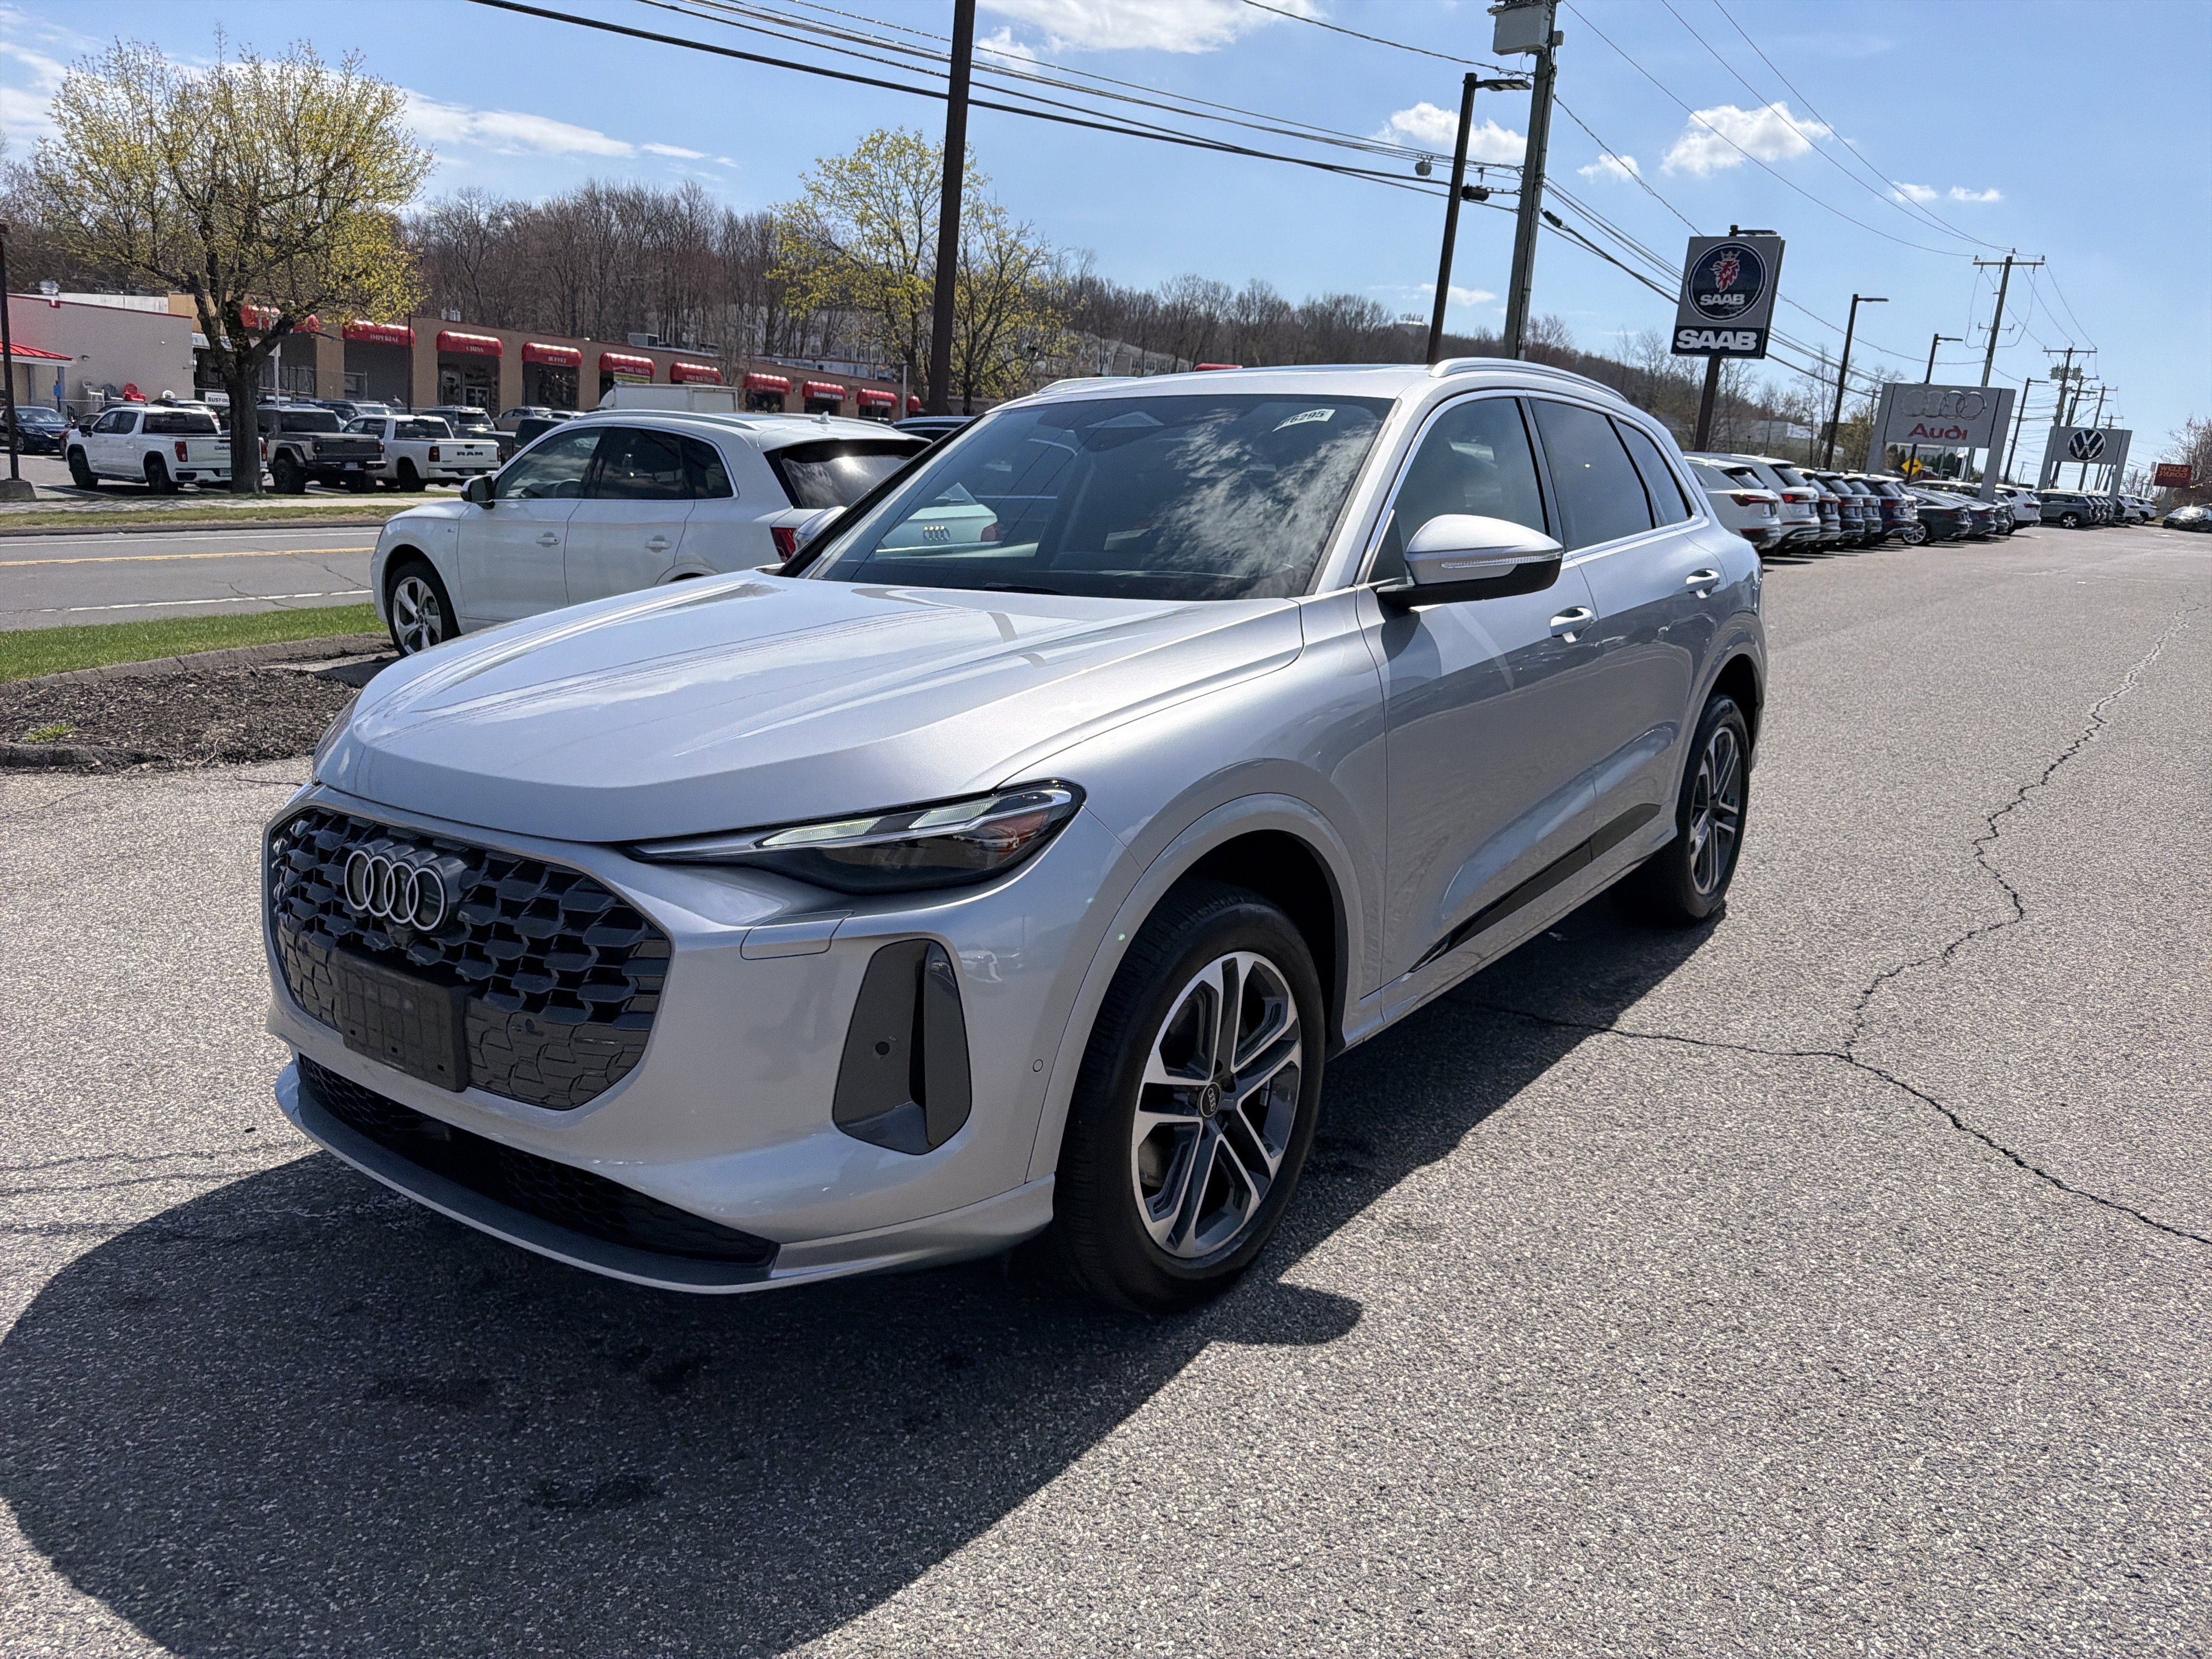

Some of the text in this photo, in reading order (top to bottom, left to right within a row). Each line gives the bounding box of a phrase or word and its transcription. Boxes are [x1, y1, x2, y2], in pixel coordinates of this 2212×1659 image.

[1700, 294, 1745, 306] SAAB
[369, 334, 399, 342] IMPERIAL
[1676, 329, 1757, 351] SAAB
[1908, 423, 1968, 441] Audi
